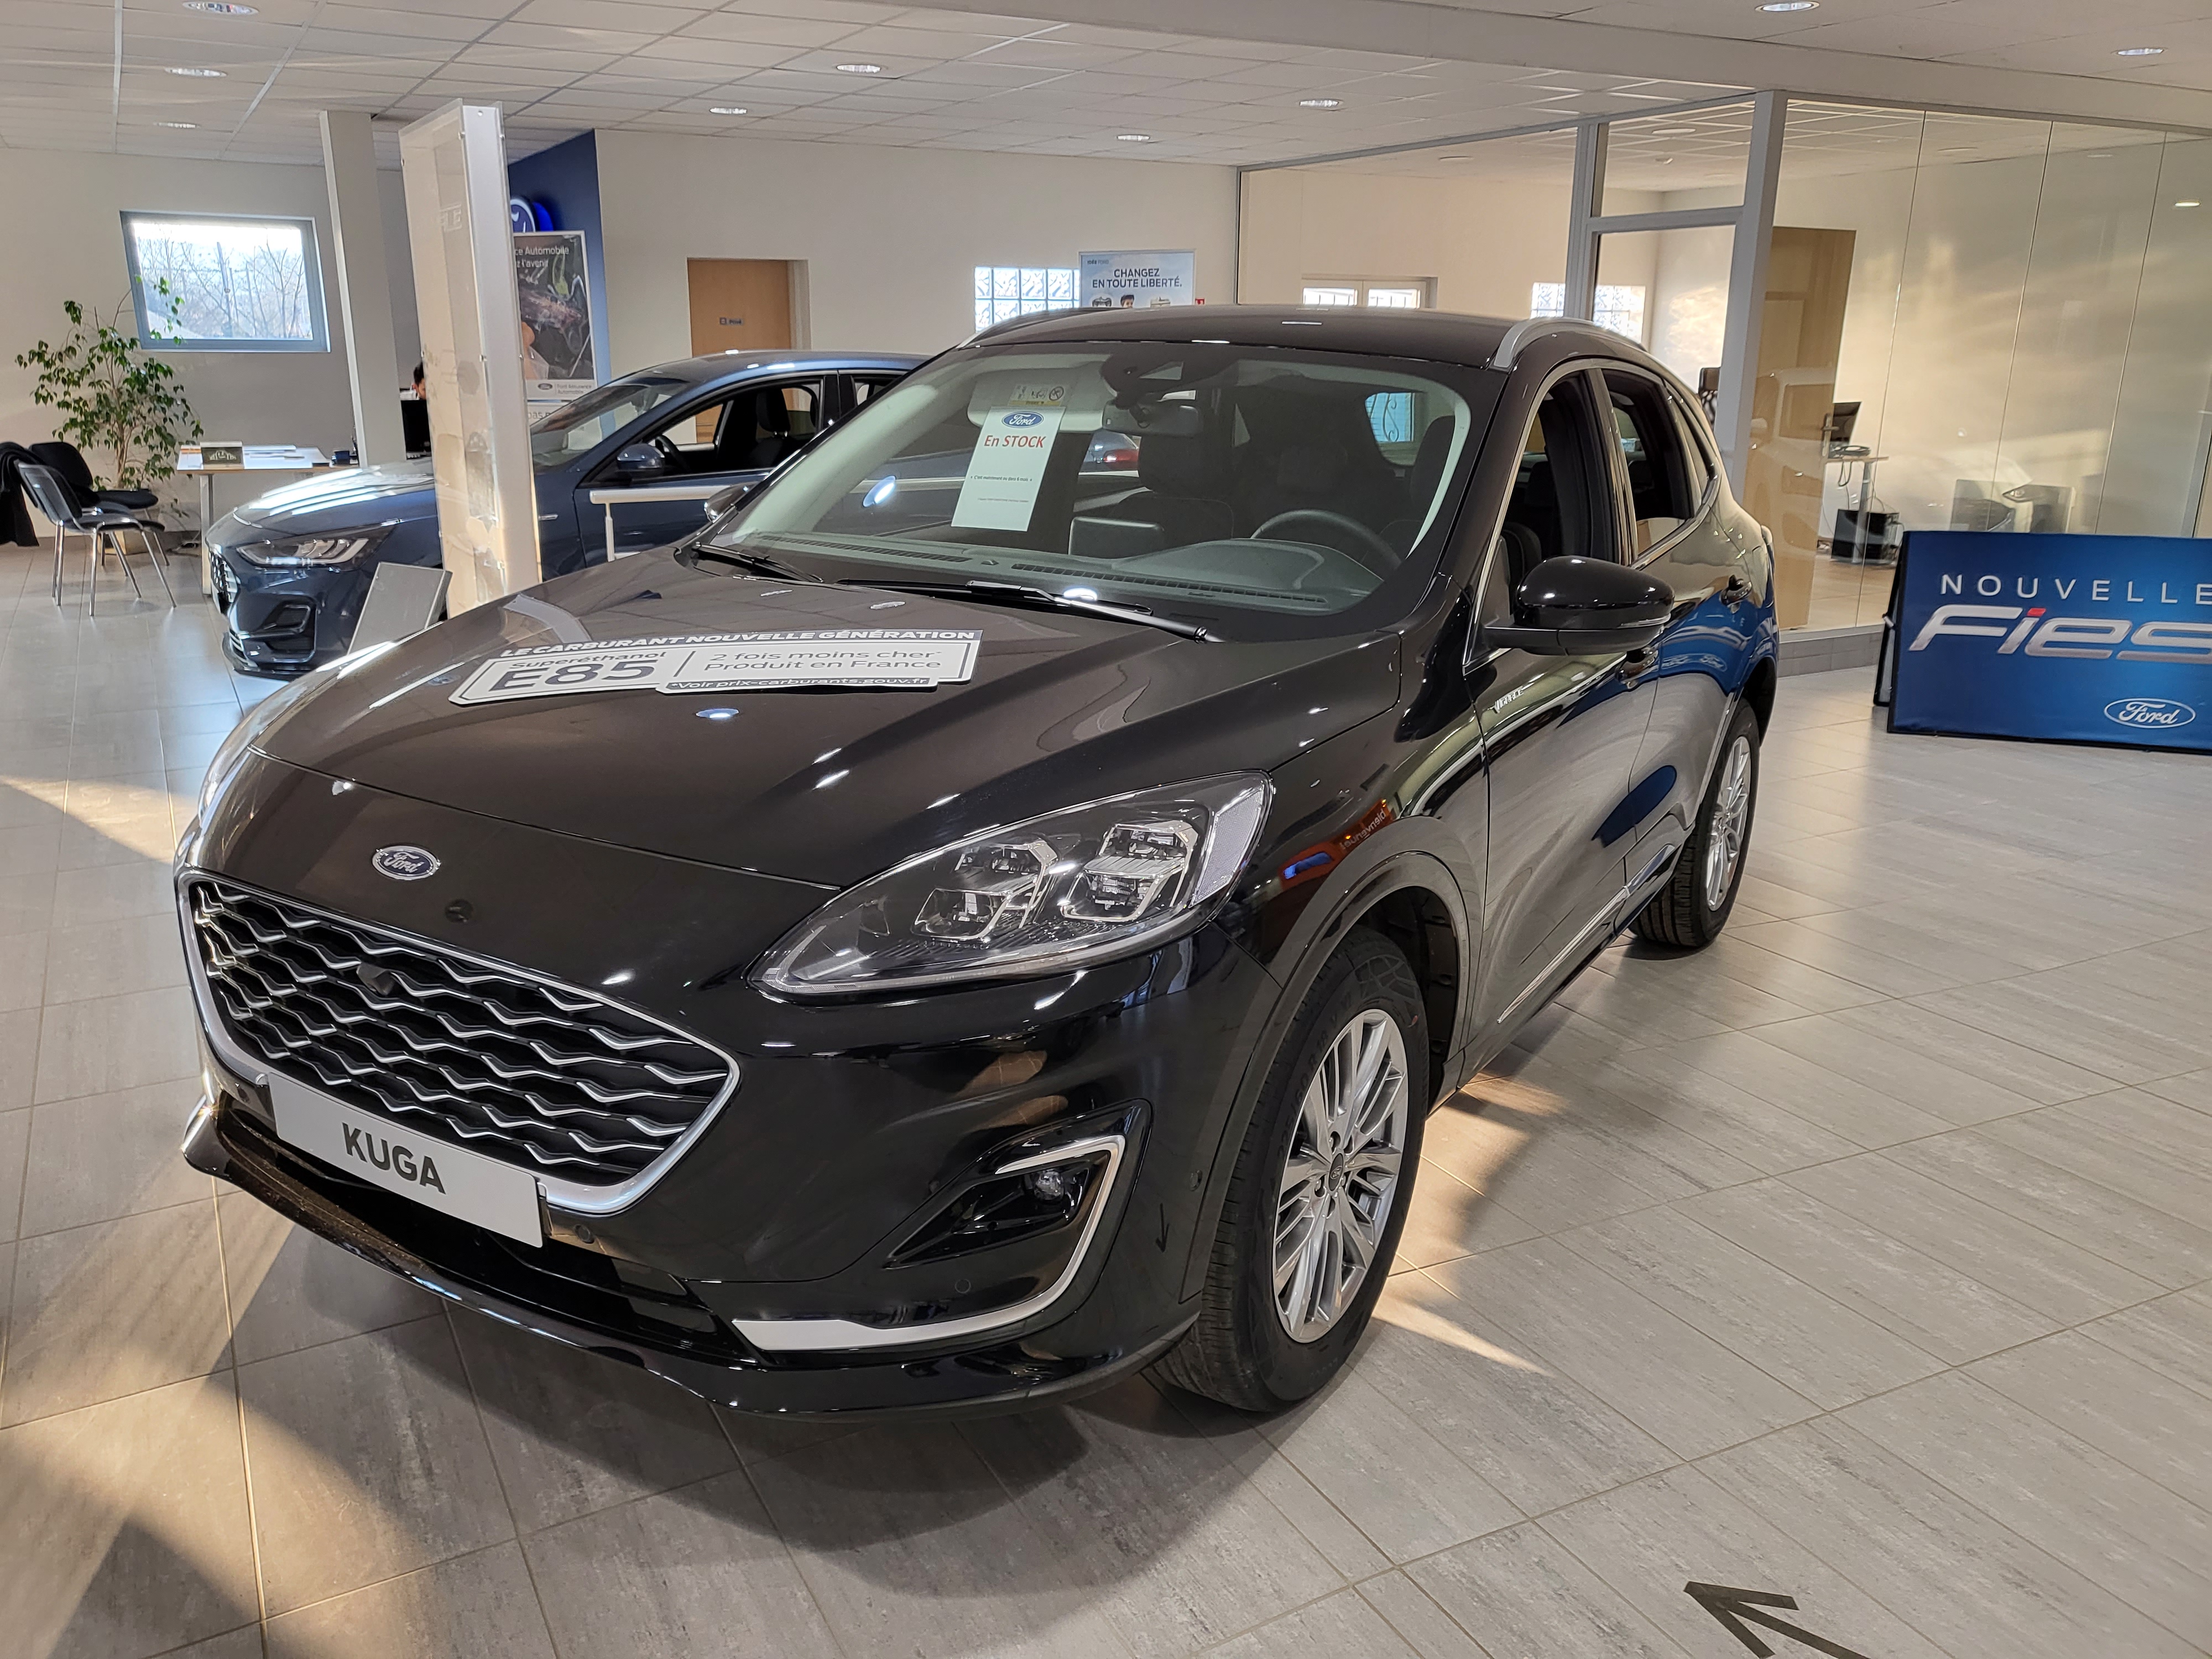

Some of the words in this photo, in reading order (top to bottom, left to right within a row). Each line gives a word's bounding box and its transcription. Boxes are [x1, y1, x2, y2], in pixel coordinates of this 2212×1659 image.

[525, 245, 569, 255] Automobile
[1113, 268, 1160, 278] CHANGEZ
[1092, 279, 1105, 288] EN
[1107, 278, 1139, 288] TOUTE
[1140, 276, 1182, 288] LIBERTÉ.
[1009, 414, 1036, 425] Ford
[984, 435, 1000, 447] En
[1002, 435, 1046, 448] STOCK
[1940, 574, 2212, 605] NOUVELLE
[500, 647, 532, 658] LE
[532, 637, 685, 655] CARBURANT
[685, 632, 816, 644] NOUVELLE
[818, 629, 975, 639] GÉNÉRATION
[511, 651, 667, 669] Superéthanol
[704, 661, 804, 671] Produit
[489, 660, 658, 692] E85
[716, 678, 928, 688] prix-carburants.gouv.fr
[2119, 701, 2180, 724] Ford
[384, 852, 425, 873] Ford
[342, 1123, 446, 1194] KUGA
